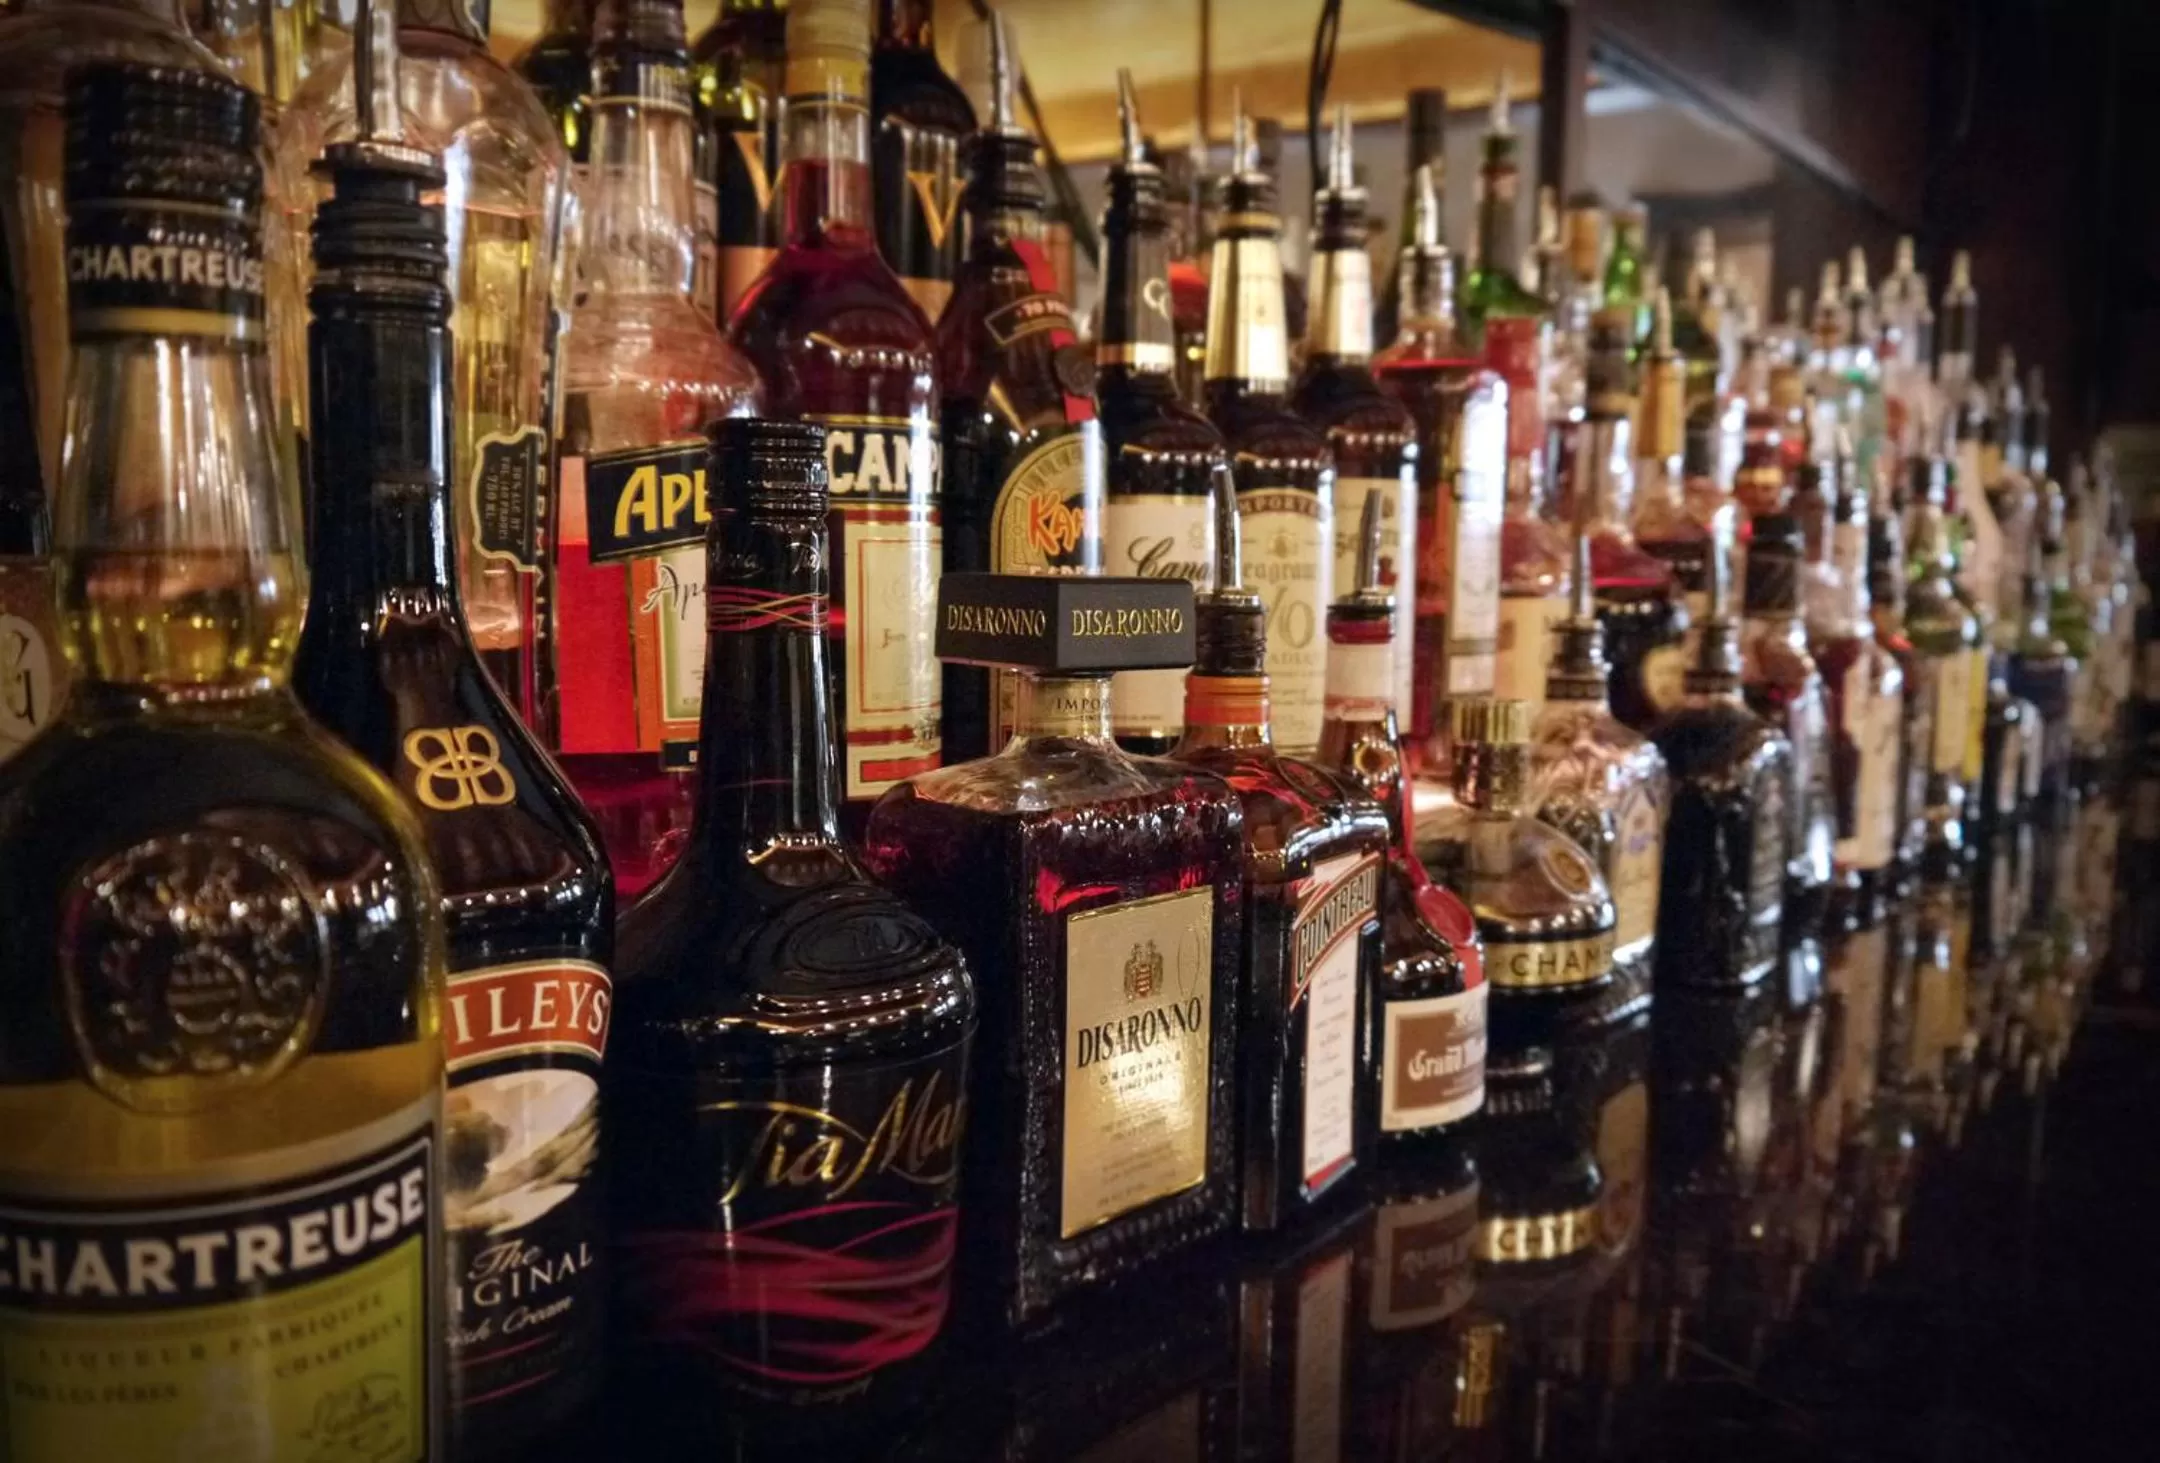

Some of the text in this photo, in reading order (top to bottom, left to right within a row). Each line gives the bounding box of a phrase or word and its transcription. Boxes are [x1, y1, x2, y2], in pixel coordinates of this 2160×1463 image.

[946, 603, 1047, 638] DISARONNO
[1071, 608, 1184, 638] DISARONNO
[1295, 863, 1378, 988] COINTREAU
[449, 980, 608, 1046] ILEYS
[1076, 996, 1202, 1070] DISARONNO
